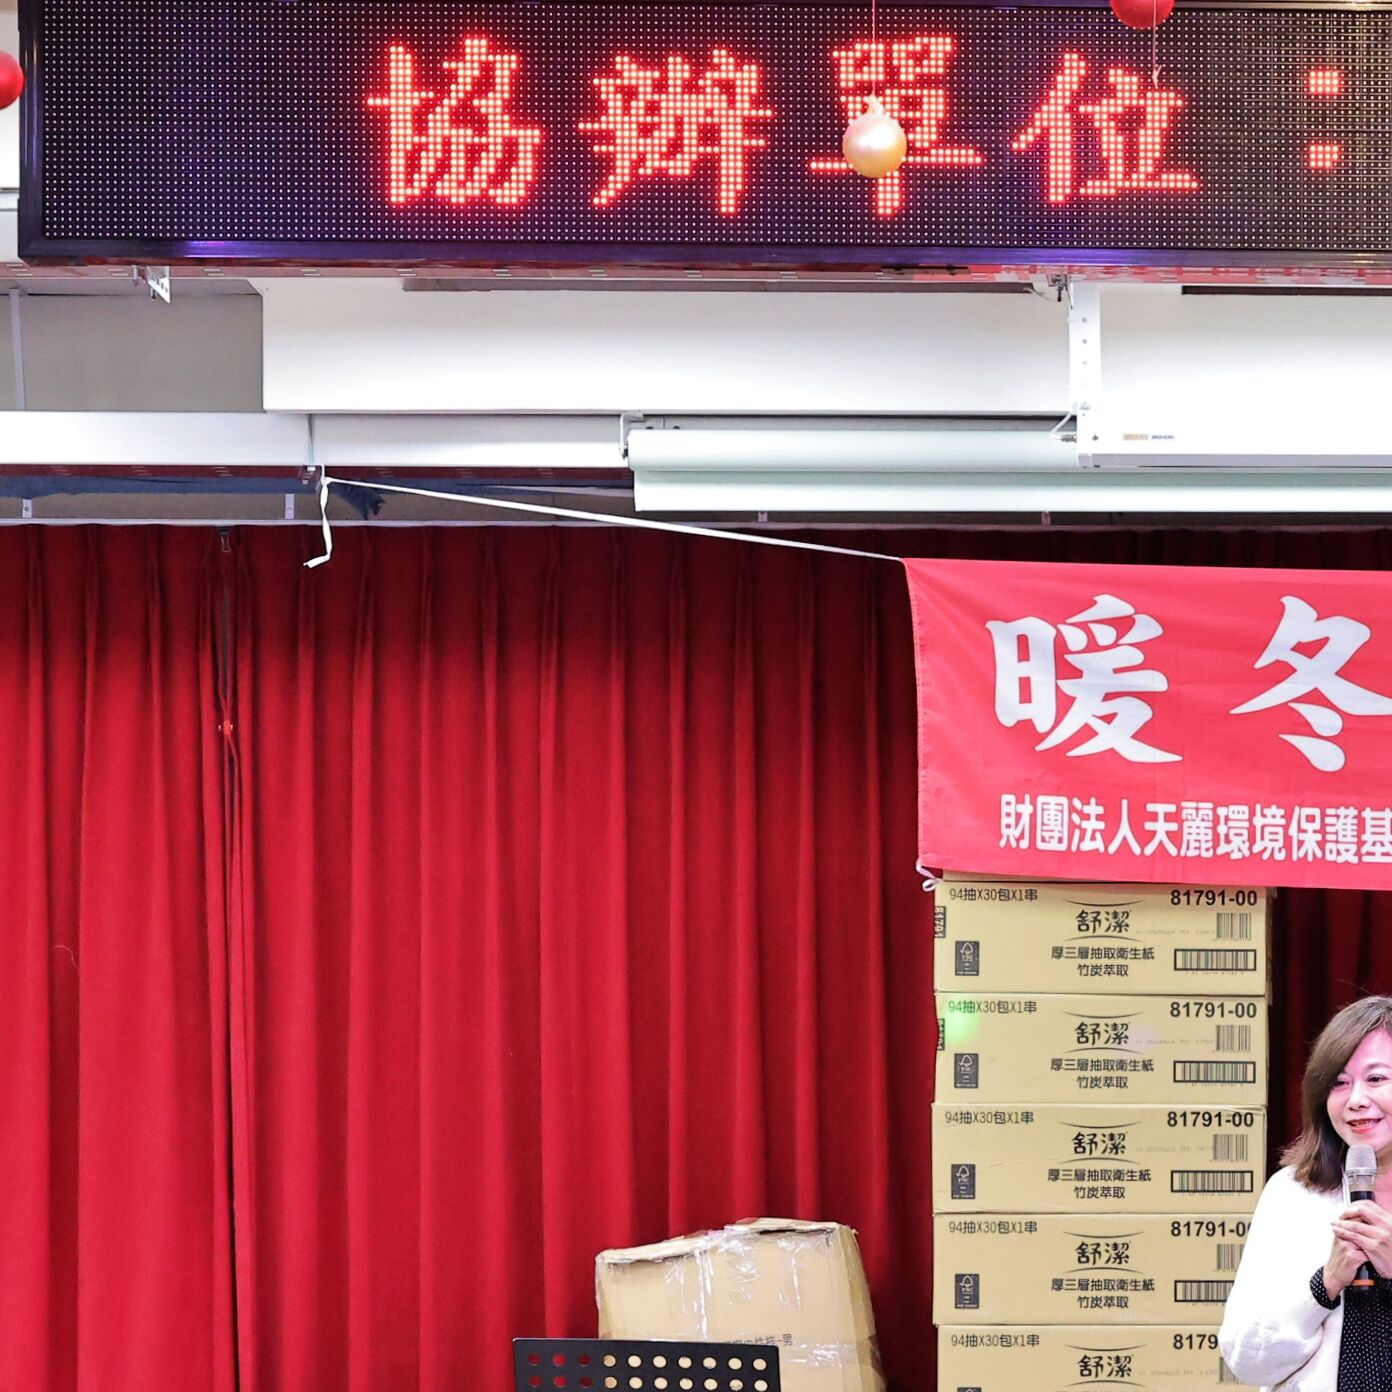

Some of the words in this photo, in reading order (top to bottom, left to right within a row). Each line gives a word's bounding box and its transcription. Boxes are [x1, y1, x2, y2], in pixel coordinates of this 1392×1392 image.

[949, 888, 1038, 901] 94抽X30包X1串
[1170, 890, 1258, 906] 81791-00
[1075, 909, 1130, 934] 舒潔
[1051, 947, 1155, 961] 厚三層抽取衛生紙
[1077, 964, 1129, 977] 竹炭萃取
[949, 1001, 1037, 1014] 94抽X30包X1串
[1170, 1002, 1257, 1018] 81791-00
[1074, 1022, 1129, 1045] 舒潔
[1050, 1059, 1154, 1072] 厚三層抽取衛生紙
[1077, 1076, 1129, 1089] 竹炭萃取
[945, 1111, 1034, 1124] 94抽X30包X1串
[1167, 1112, 1254, 1127] 81791-00
[1072, 1132, 1126, 1156] 舒潔
[1048, 1169, 1151, 1182] 厚三層抽取衛生紙
[1074, 1186, 1126, 1199] 竹炭萃取
[949, 1221, 1037, 1234] 94抽X30包X1串
[1170, 1221, 1251, 1237] 81791-0
[1075, 1242, 1130, 1265] 舒潔
[1051, 1278, 1155, 1292] 厚三層抽取衛生紙
[1077, 1296, 1129, 1309] 竹炭萃取
[951, 1334, 1040, 1348] 94抽X30包X1串
[1077, 1355, 1133, 1378] 舒潔
